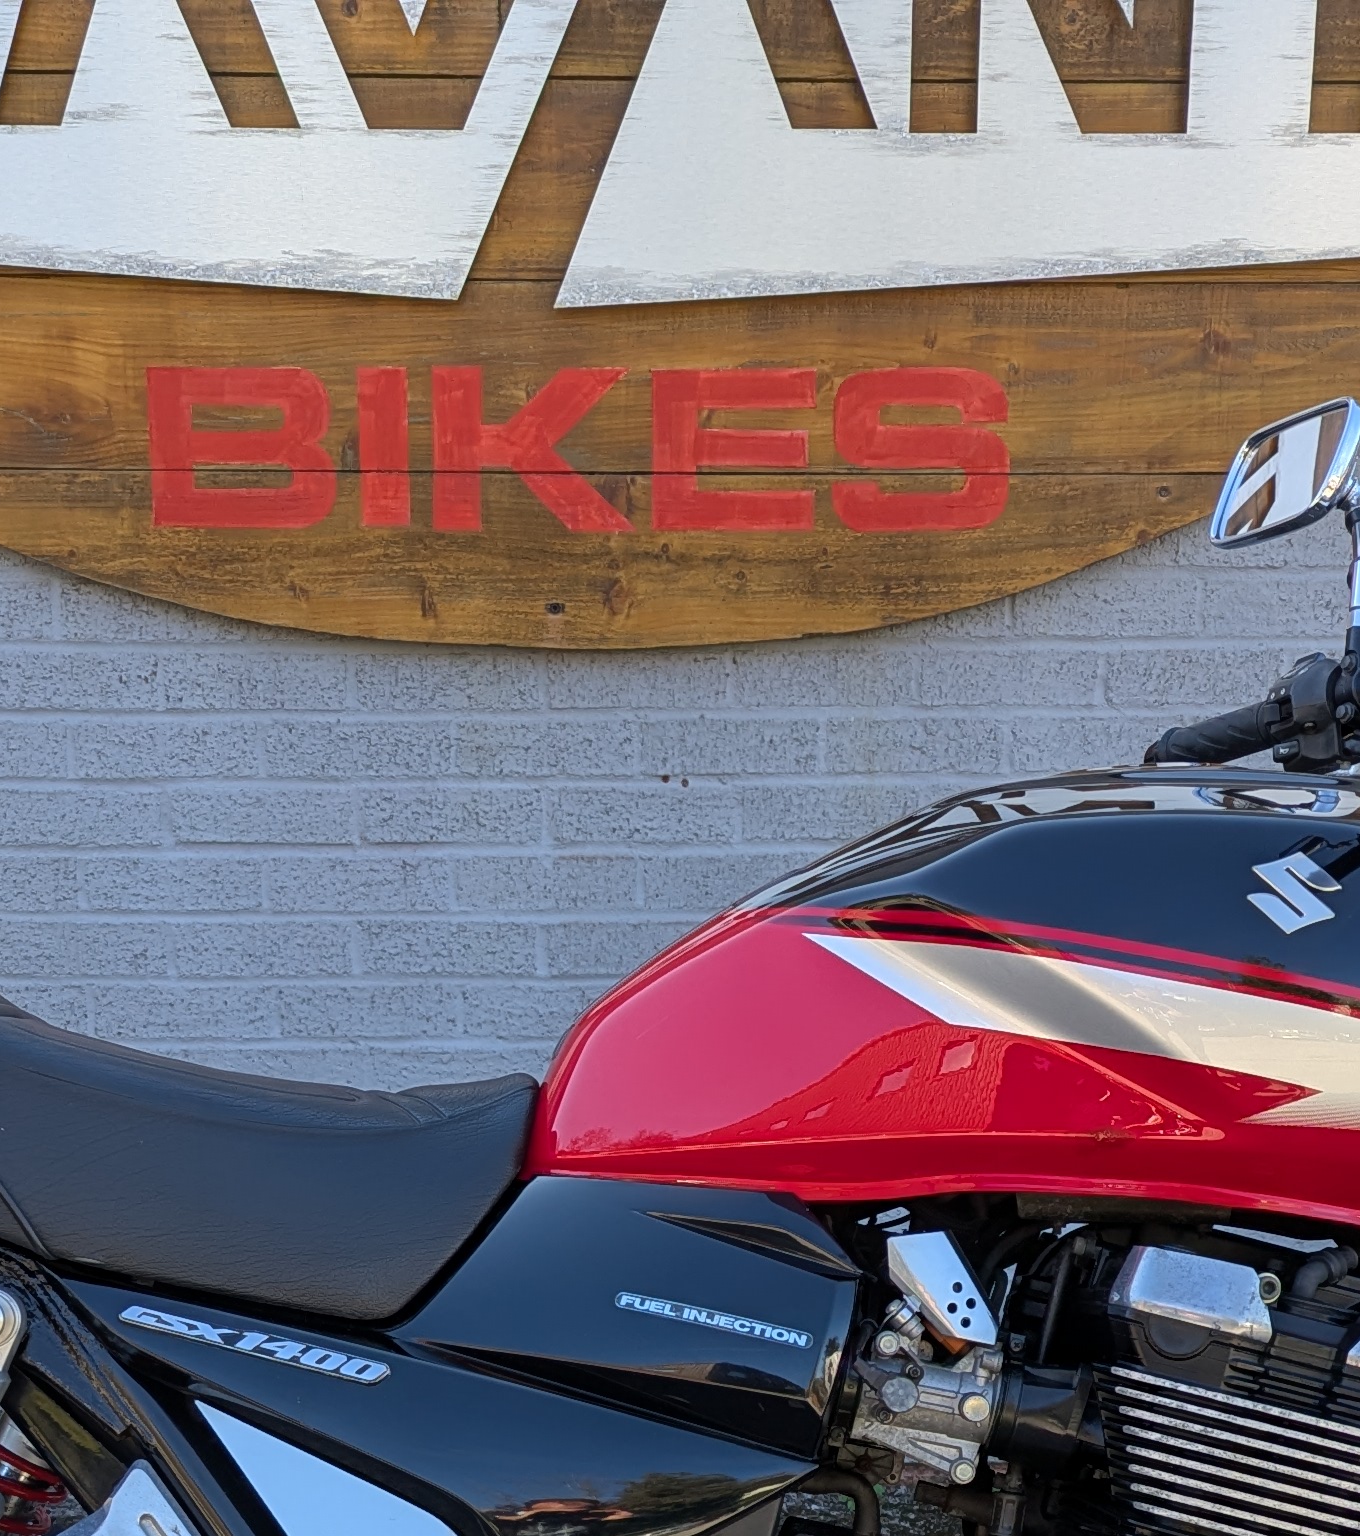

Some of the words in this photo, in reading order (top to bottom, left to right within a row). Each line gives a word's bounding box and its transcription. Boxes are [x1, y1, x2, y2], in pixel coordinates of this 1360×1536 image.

[146, 366, 1011, 535] BIKES
[120, 1305, 389, 1384] GSX1400
[618, 1293, 677, 1317] FUEL
[681, 1304, 810, 1346] INJECTION
